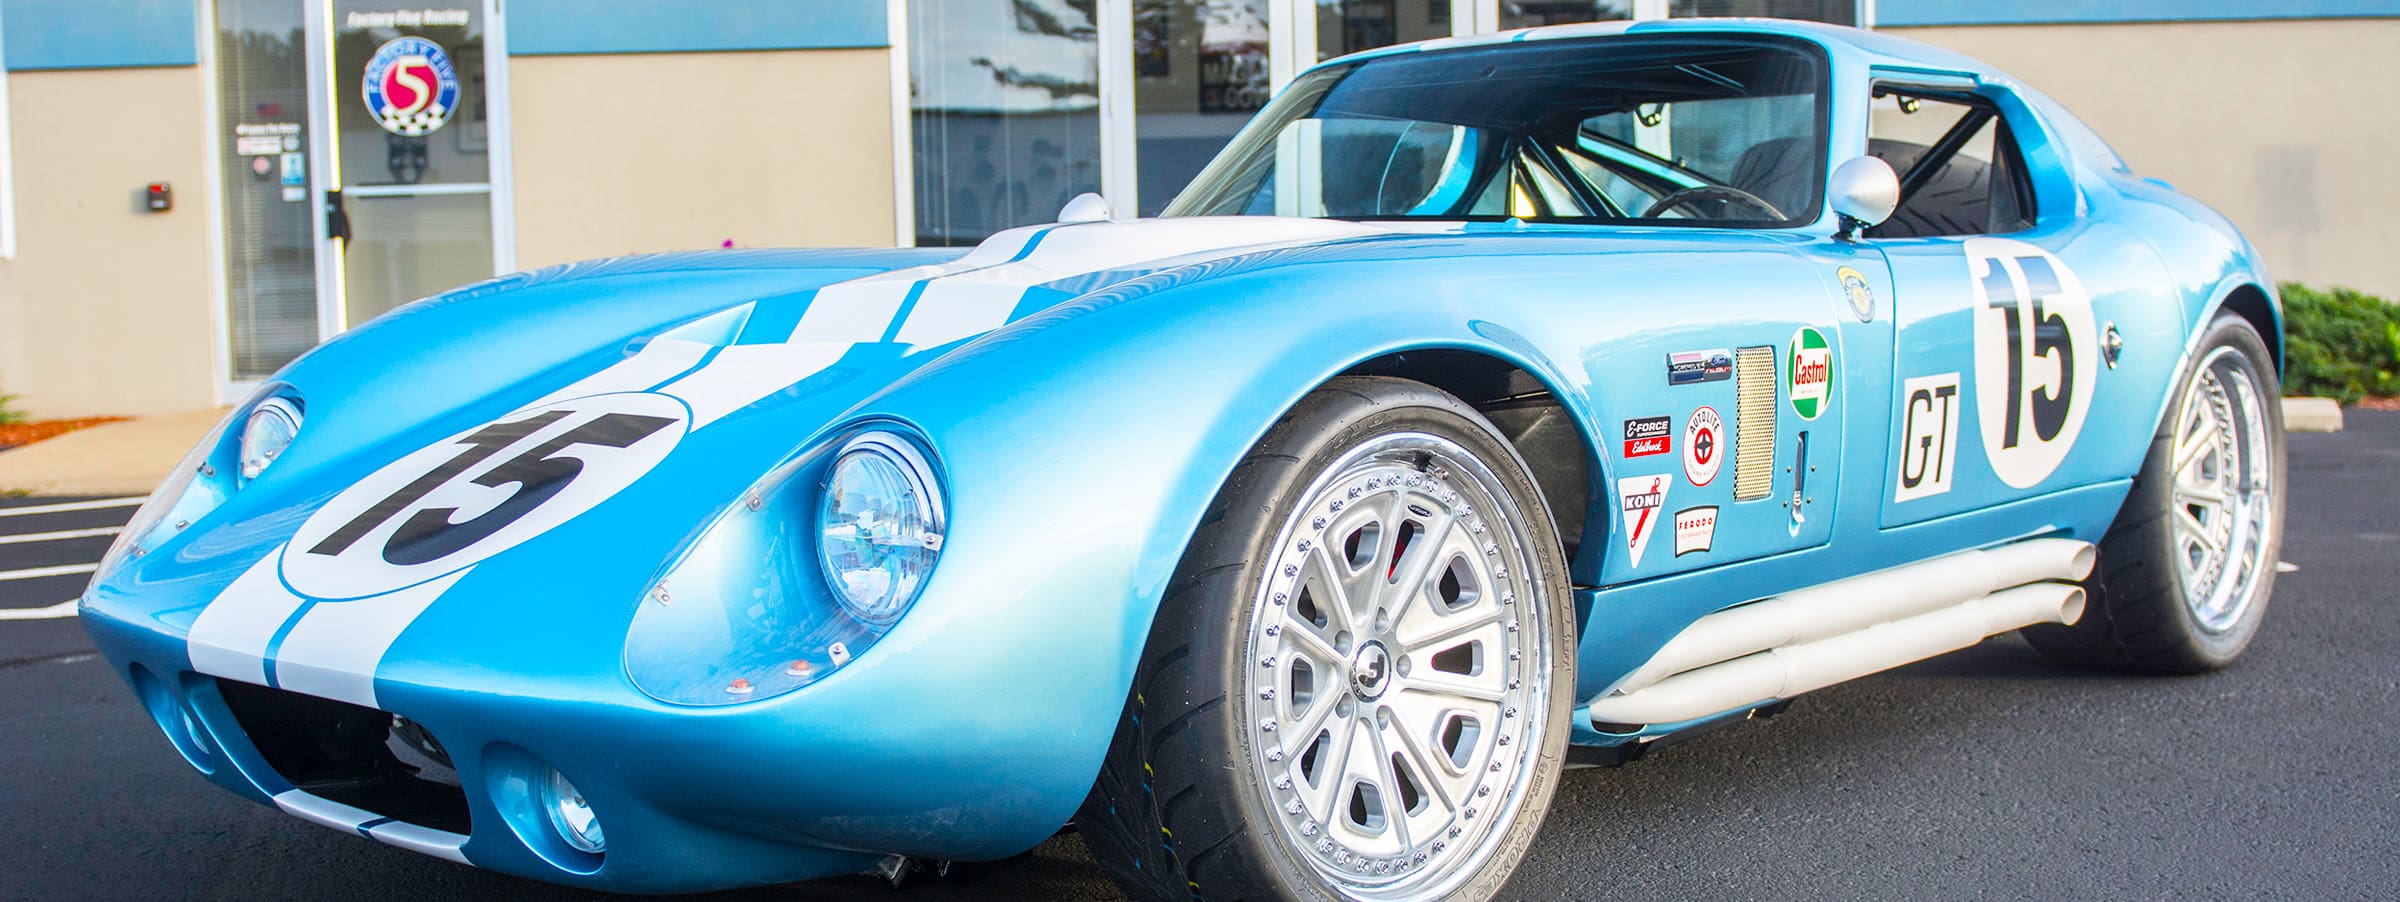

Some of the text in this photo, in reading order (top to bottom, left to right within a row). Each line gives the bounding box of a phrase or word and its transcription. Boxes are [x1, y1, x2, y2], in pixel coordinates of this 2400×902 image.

[396, 55, 429, 114] 5
[1980, 255, 2074, 450] 15
[1795, 353, 1827, 385] Castrol
[1627, 420, 1669, 437] E-FORCE
[1689, 411, 1720, 435] AUTOLITE
[1902, 384, 1957, 489] GT
[306, 410, 681, 566] 15
[1626, 493, 1660, 509] KONI
[1678, 517, 1713, 530] FERODO
